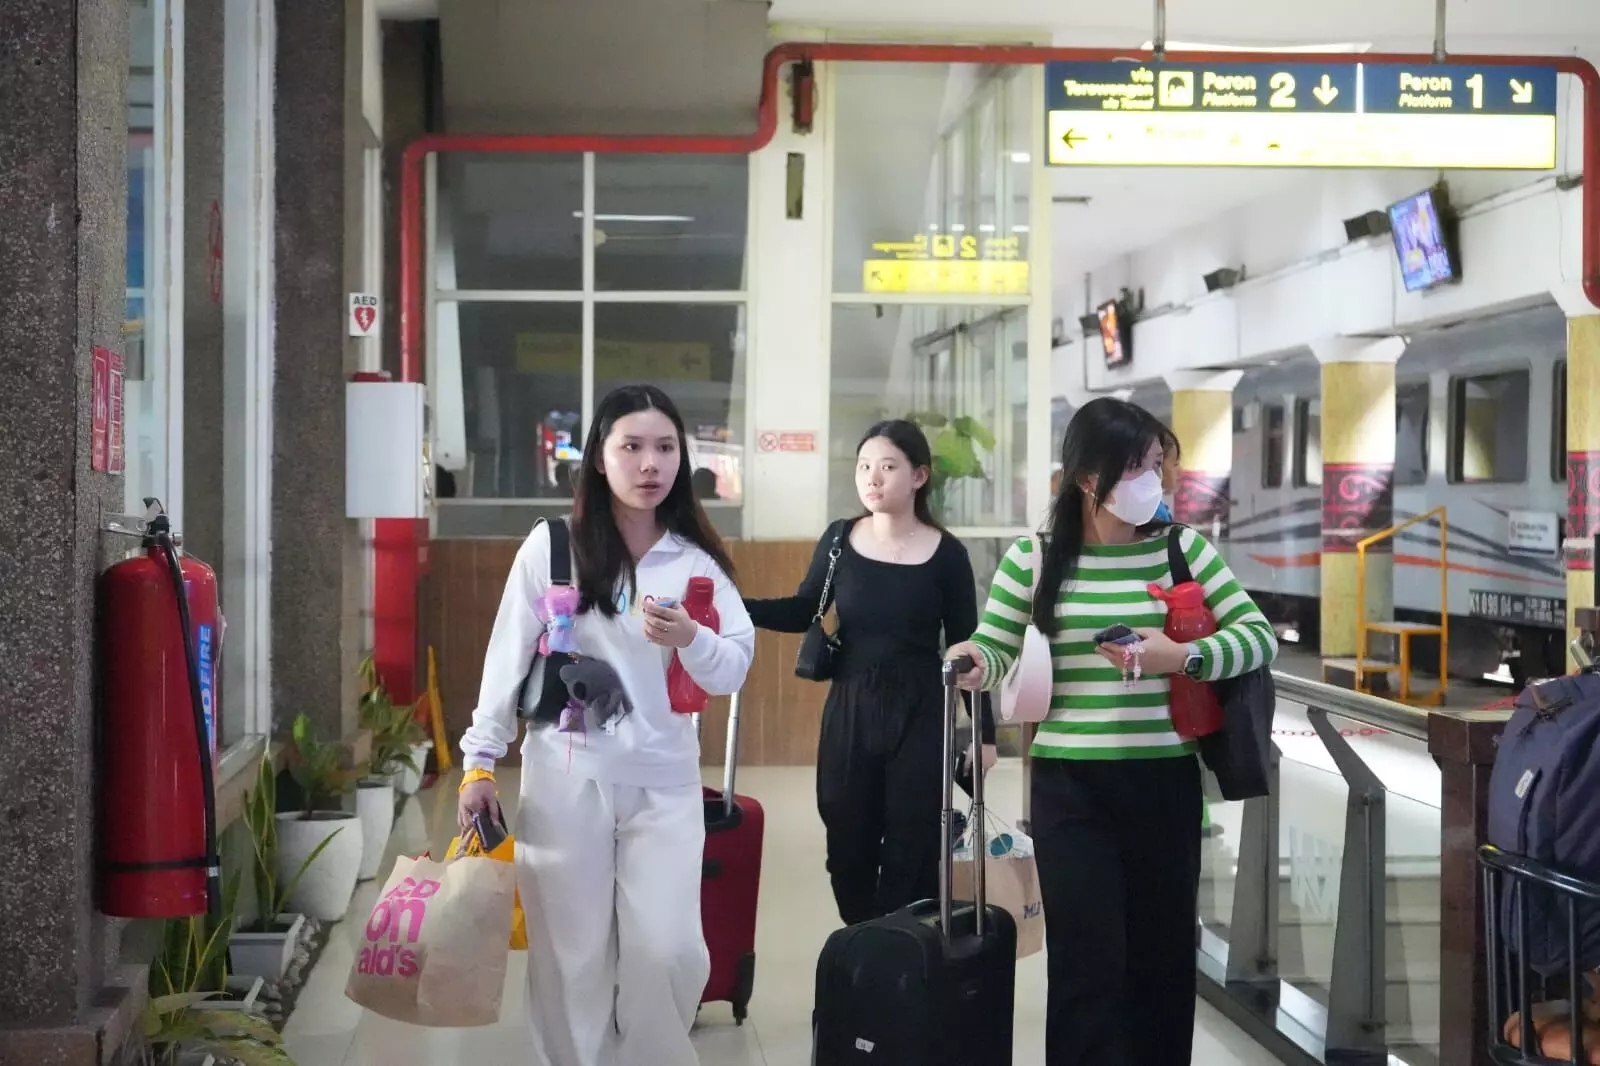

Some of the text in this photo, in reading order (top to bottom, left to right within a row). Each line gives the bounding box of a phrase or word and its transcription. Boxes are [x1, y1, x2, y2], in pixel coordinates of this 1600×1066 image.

[1202, 91, 1257, 107] Platform
[1203, 72, 1296, 108] Peron 2
[1399, 93, 1452, 108] Platform
[1400, 72, 1483, 108] Peron 1
[353, 296, 377, 306] AED
[366, 898, 426, 944] on
